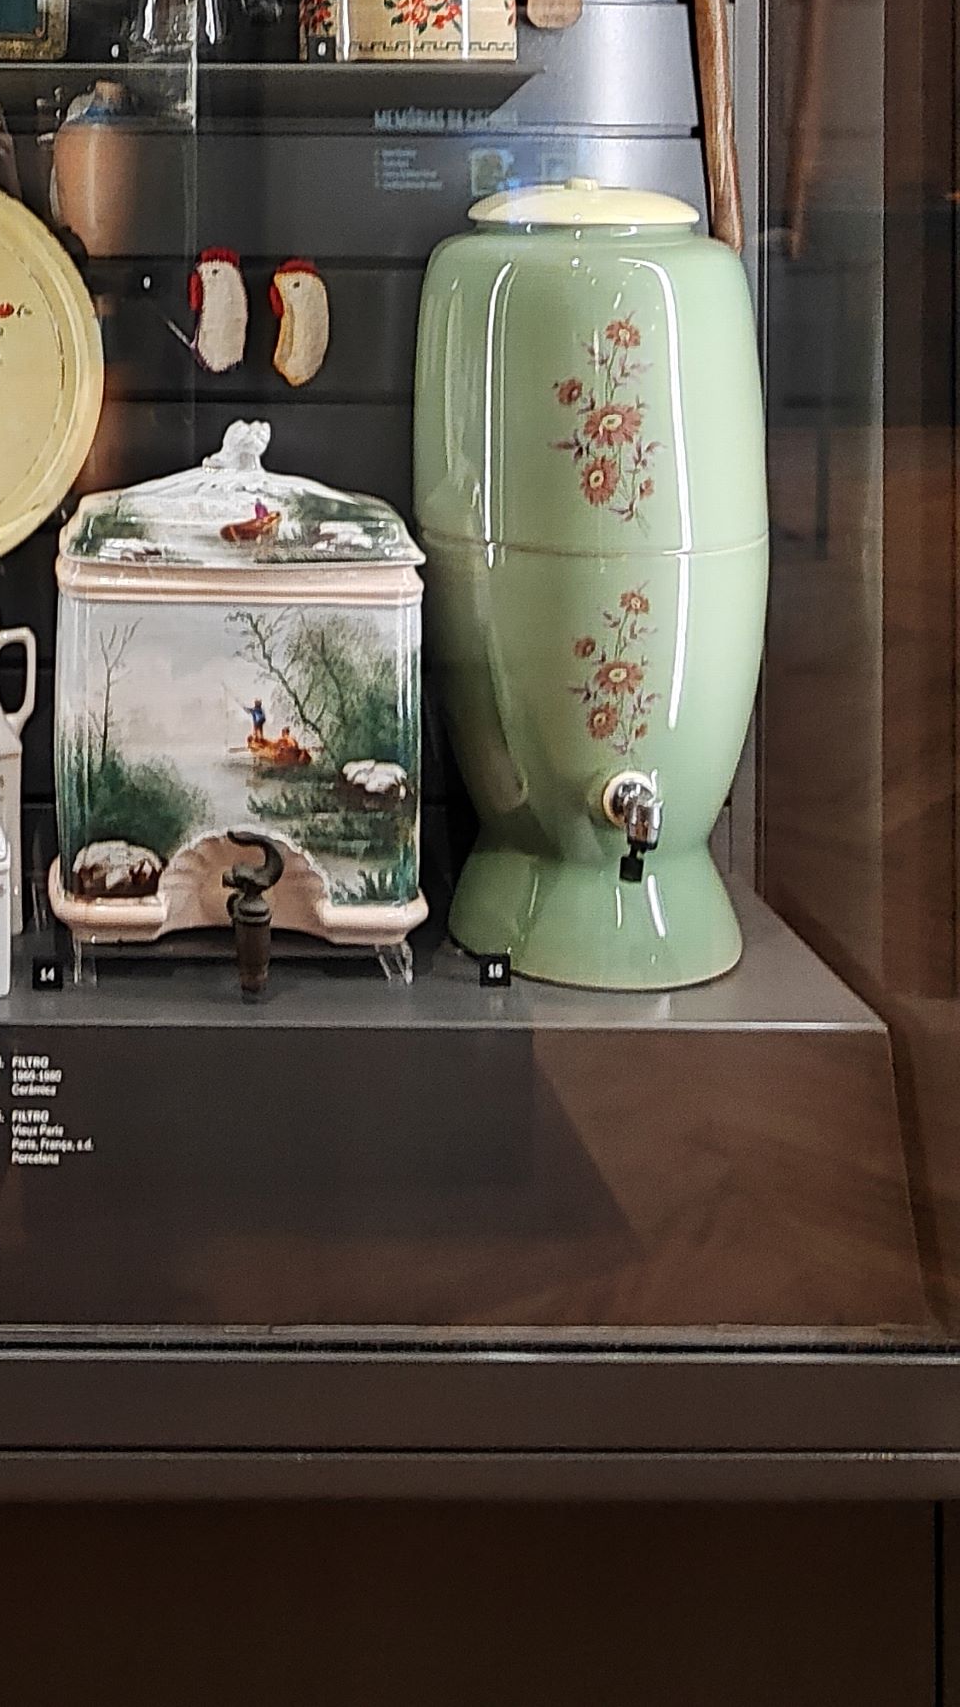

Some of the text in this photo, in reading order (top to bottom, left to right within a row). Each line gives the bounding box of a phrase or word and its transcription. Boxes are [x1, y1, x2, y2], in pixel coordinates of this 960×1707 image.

[39, 966, 56, 983] 14
[487, 963, 504, 979] 15
[11, 1083, 56, 1096] Cerâmica
[11, 1152, 59, 1165] Porcelana
